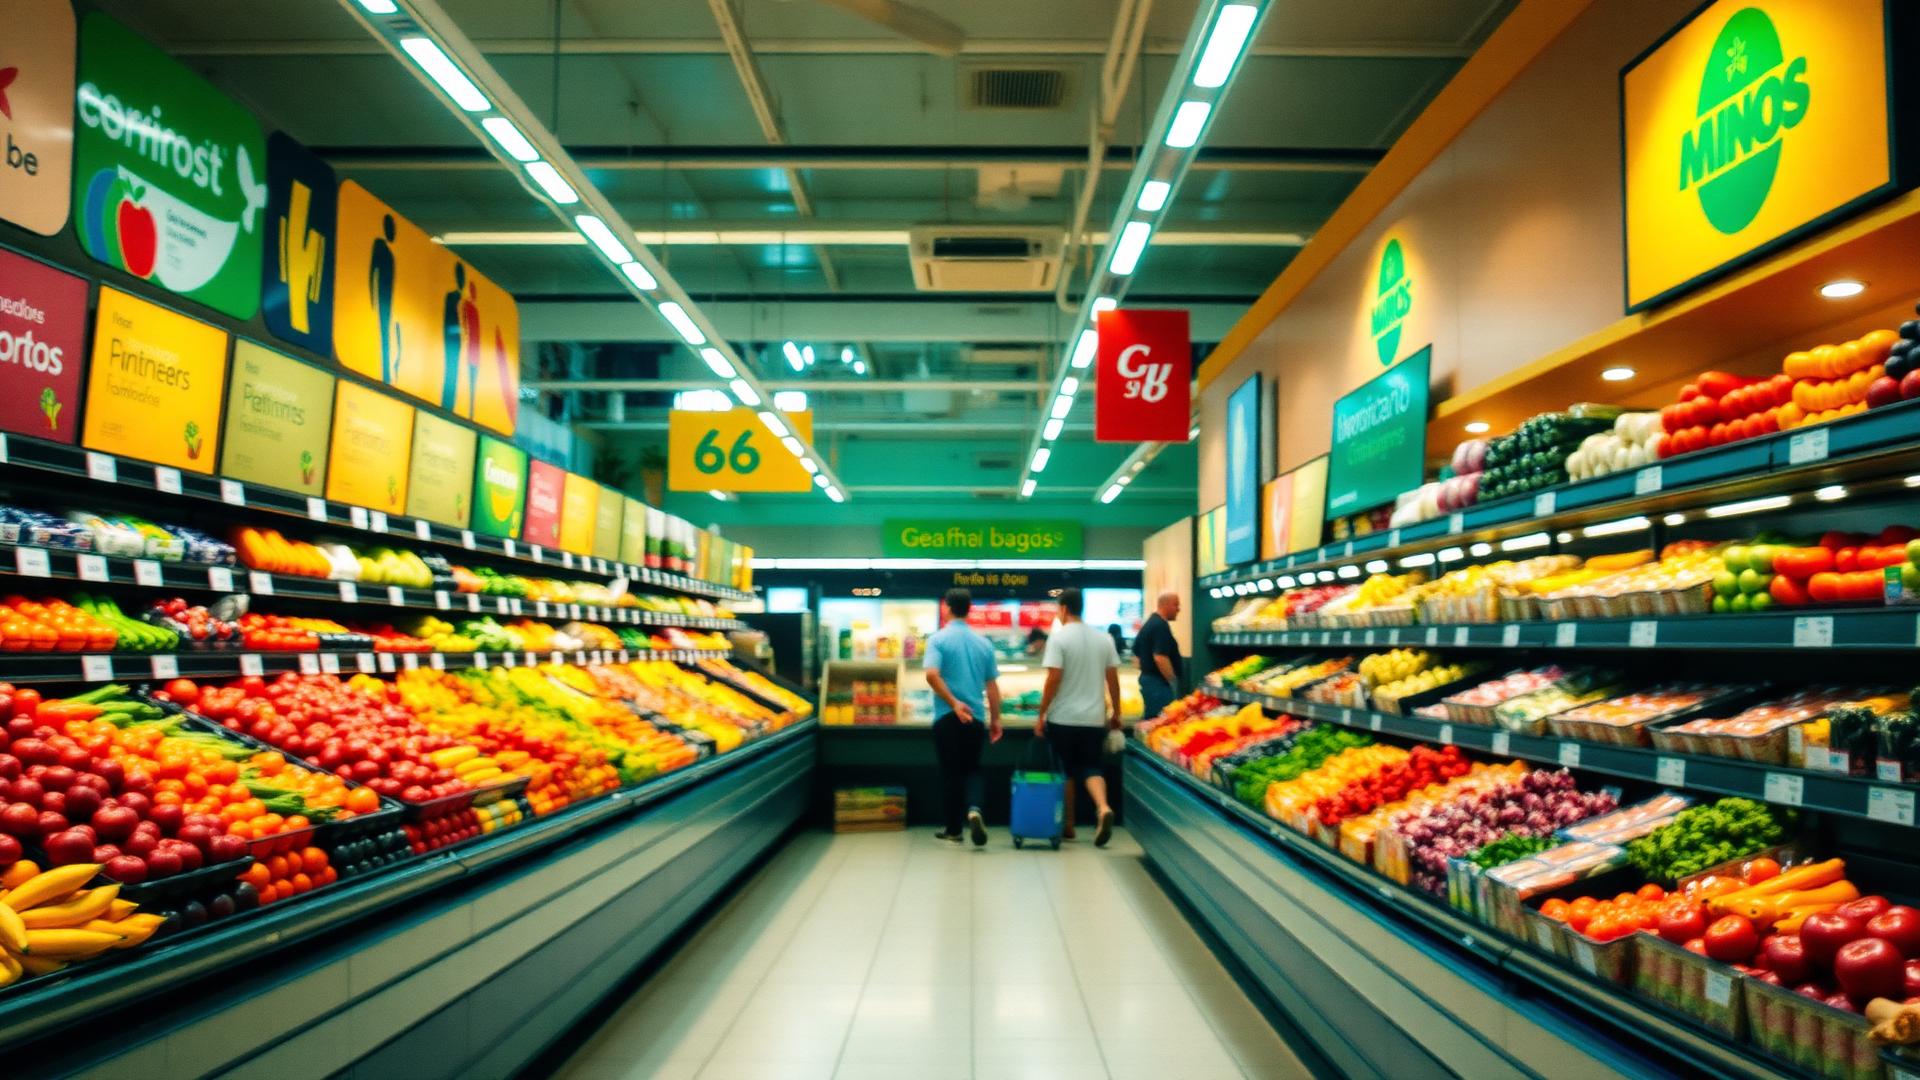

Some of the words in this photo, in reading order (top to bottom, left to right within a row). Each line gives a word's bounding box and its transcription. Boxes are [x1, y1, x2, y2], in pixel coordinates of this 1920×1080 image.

[1680, 56, 1810, 191] MINOS
[7, 133, 38, 176] be
[694, 428, 761, 475] 66
